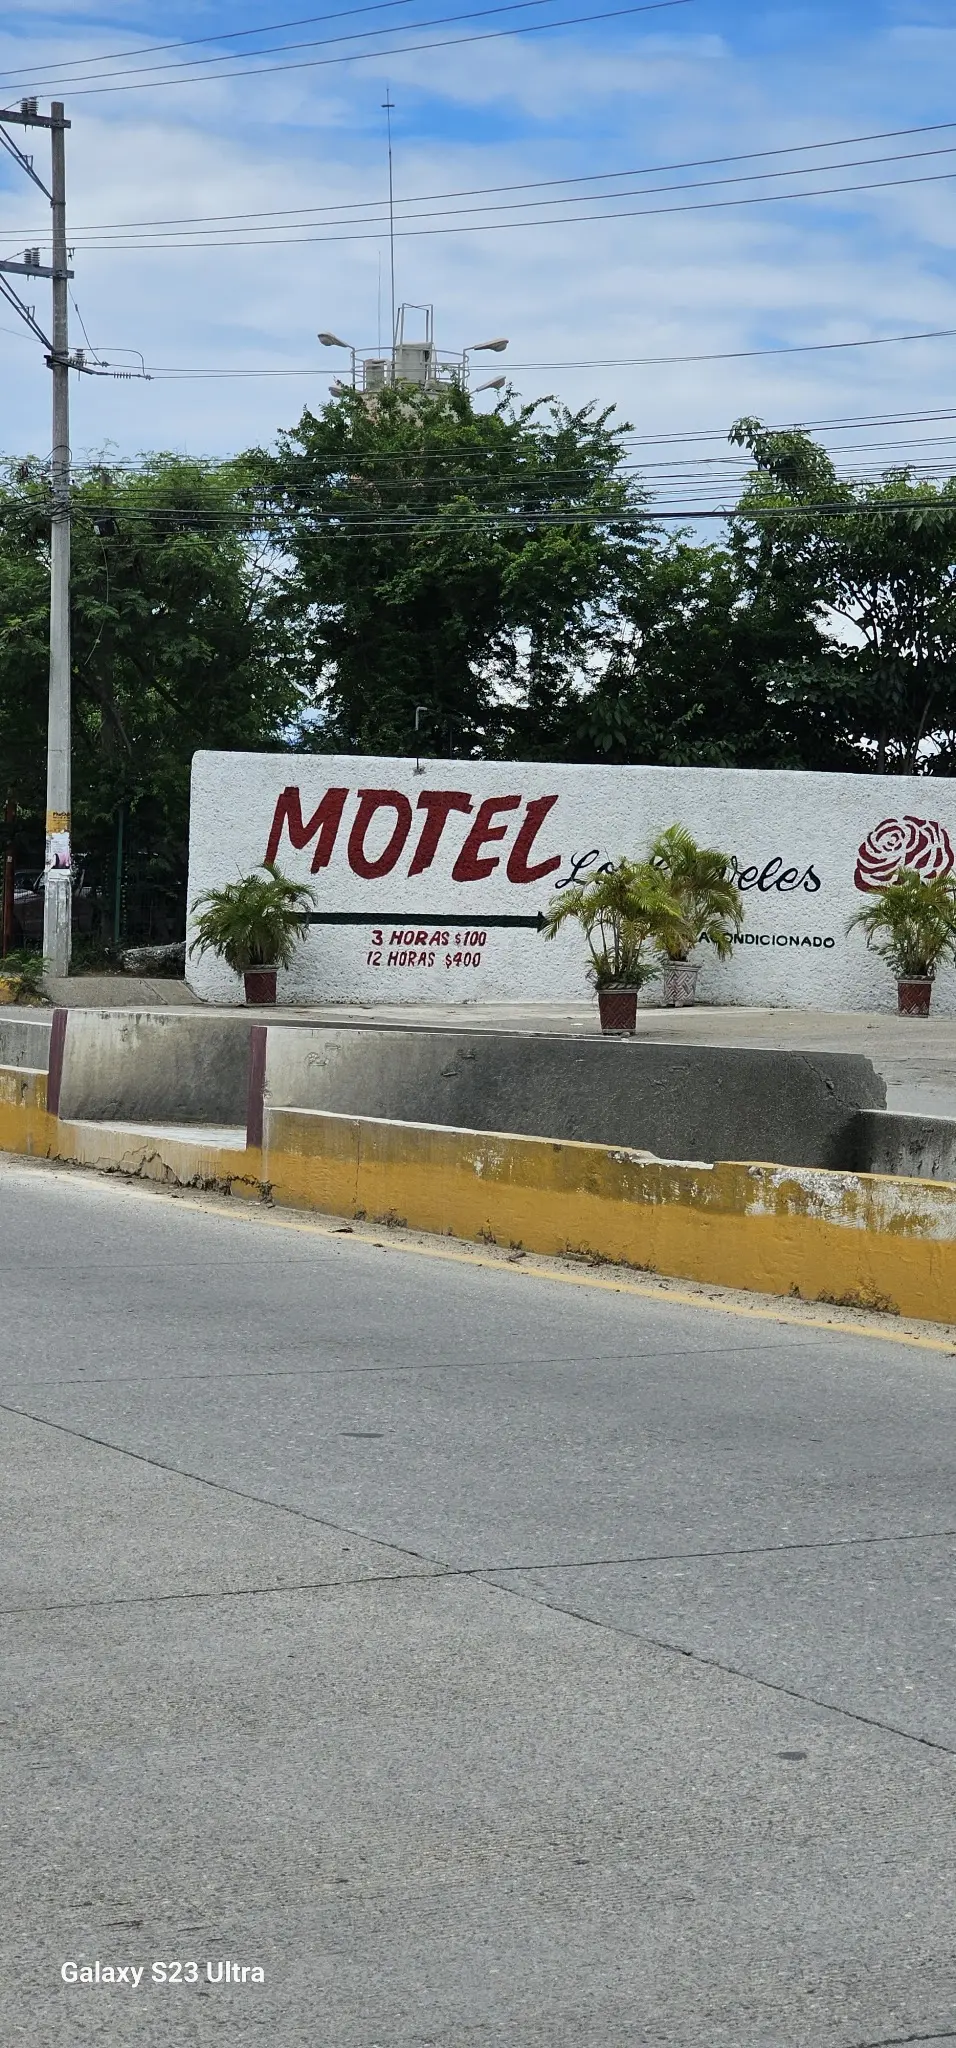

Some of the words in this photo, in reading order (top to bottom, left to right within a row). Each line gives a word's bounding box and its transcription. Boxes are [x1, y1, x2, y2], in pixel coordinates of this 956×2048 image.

[264, 786, 562, 884] MOTEL
[555, 849, 626, 888] Lo
[371, 930, 384, 946] 3
[388, 930, 450, 946] HORAS
[454, 930, 487, 947] $100
[366, 951, 383, 966] 12
[387, 950, 436, 967] HORAS
[445, 952, 481, 969] $400
